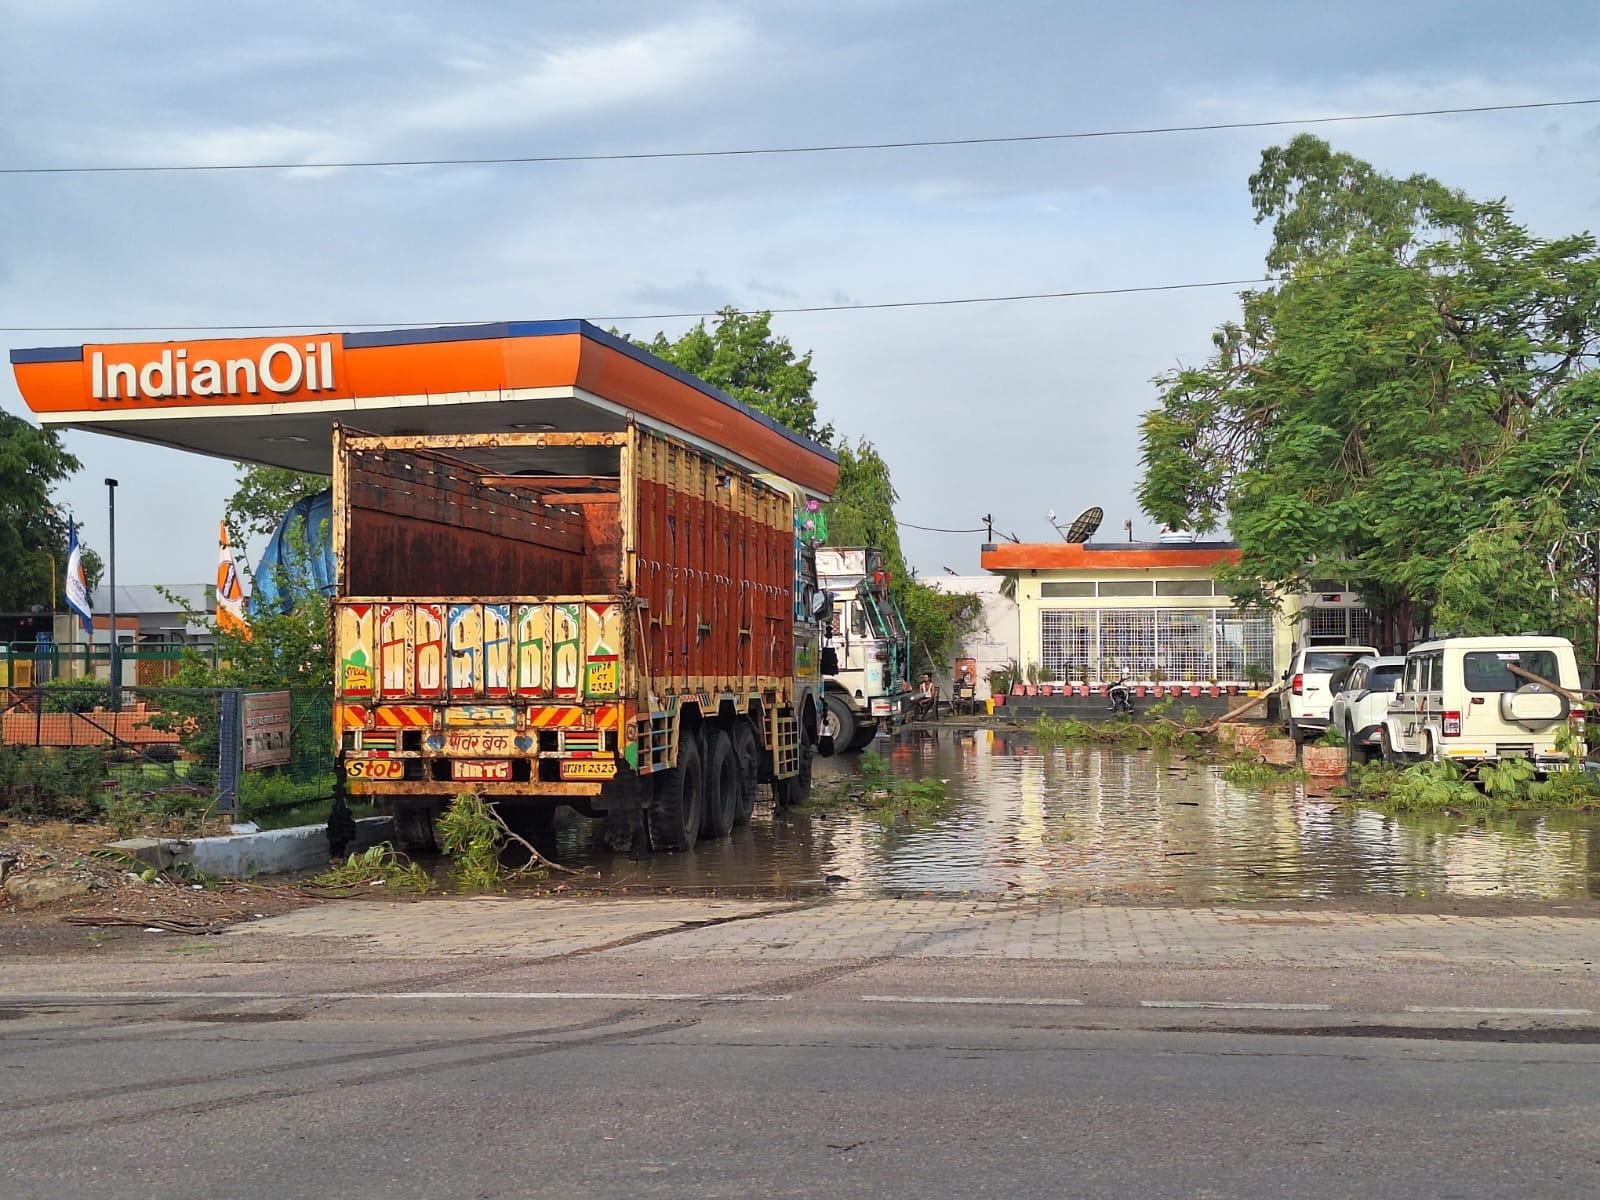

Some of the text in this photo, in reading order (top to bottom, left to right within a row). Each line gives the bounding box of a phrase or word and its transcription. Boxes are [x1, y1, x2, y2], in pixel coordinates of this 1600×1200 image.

[92, 341, 334, 399] IndianOil
[383, 641, 578, 689] HORN DO
[591, 682, 613, 692] 2323
[588, 763, 615, 774] 2323
